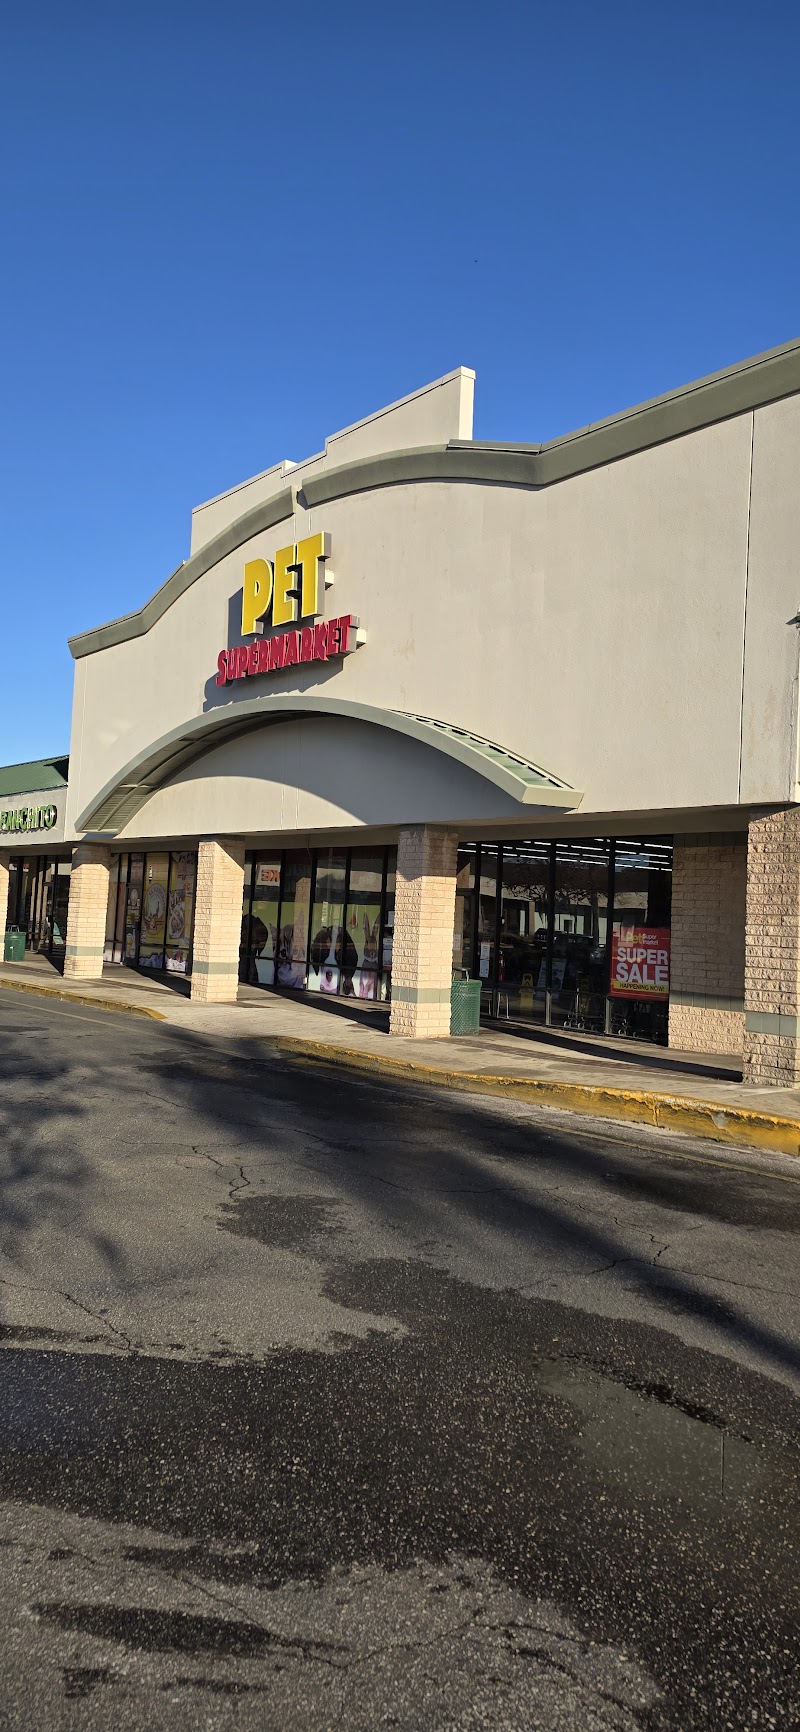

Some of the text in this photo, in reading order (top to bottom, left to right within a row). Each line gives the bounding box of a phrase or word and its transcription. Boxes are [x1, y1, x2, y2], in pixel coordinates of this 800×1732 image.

[241, 531, 331, 636] PET
[215, 614, 358, 687] SUPERMARKET
[617, 947, 669, 965] SUPER
[615, 962, 669, 986] SALE
[619, 982, 649, 991] HAPPENING
